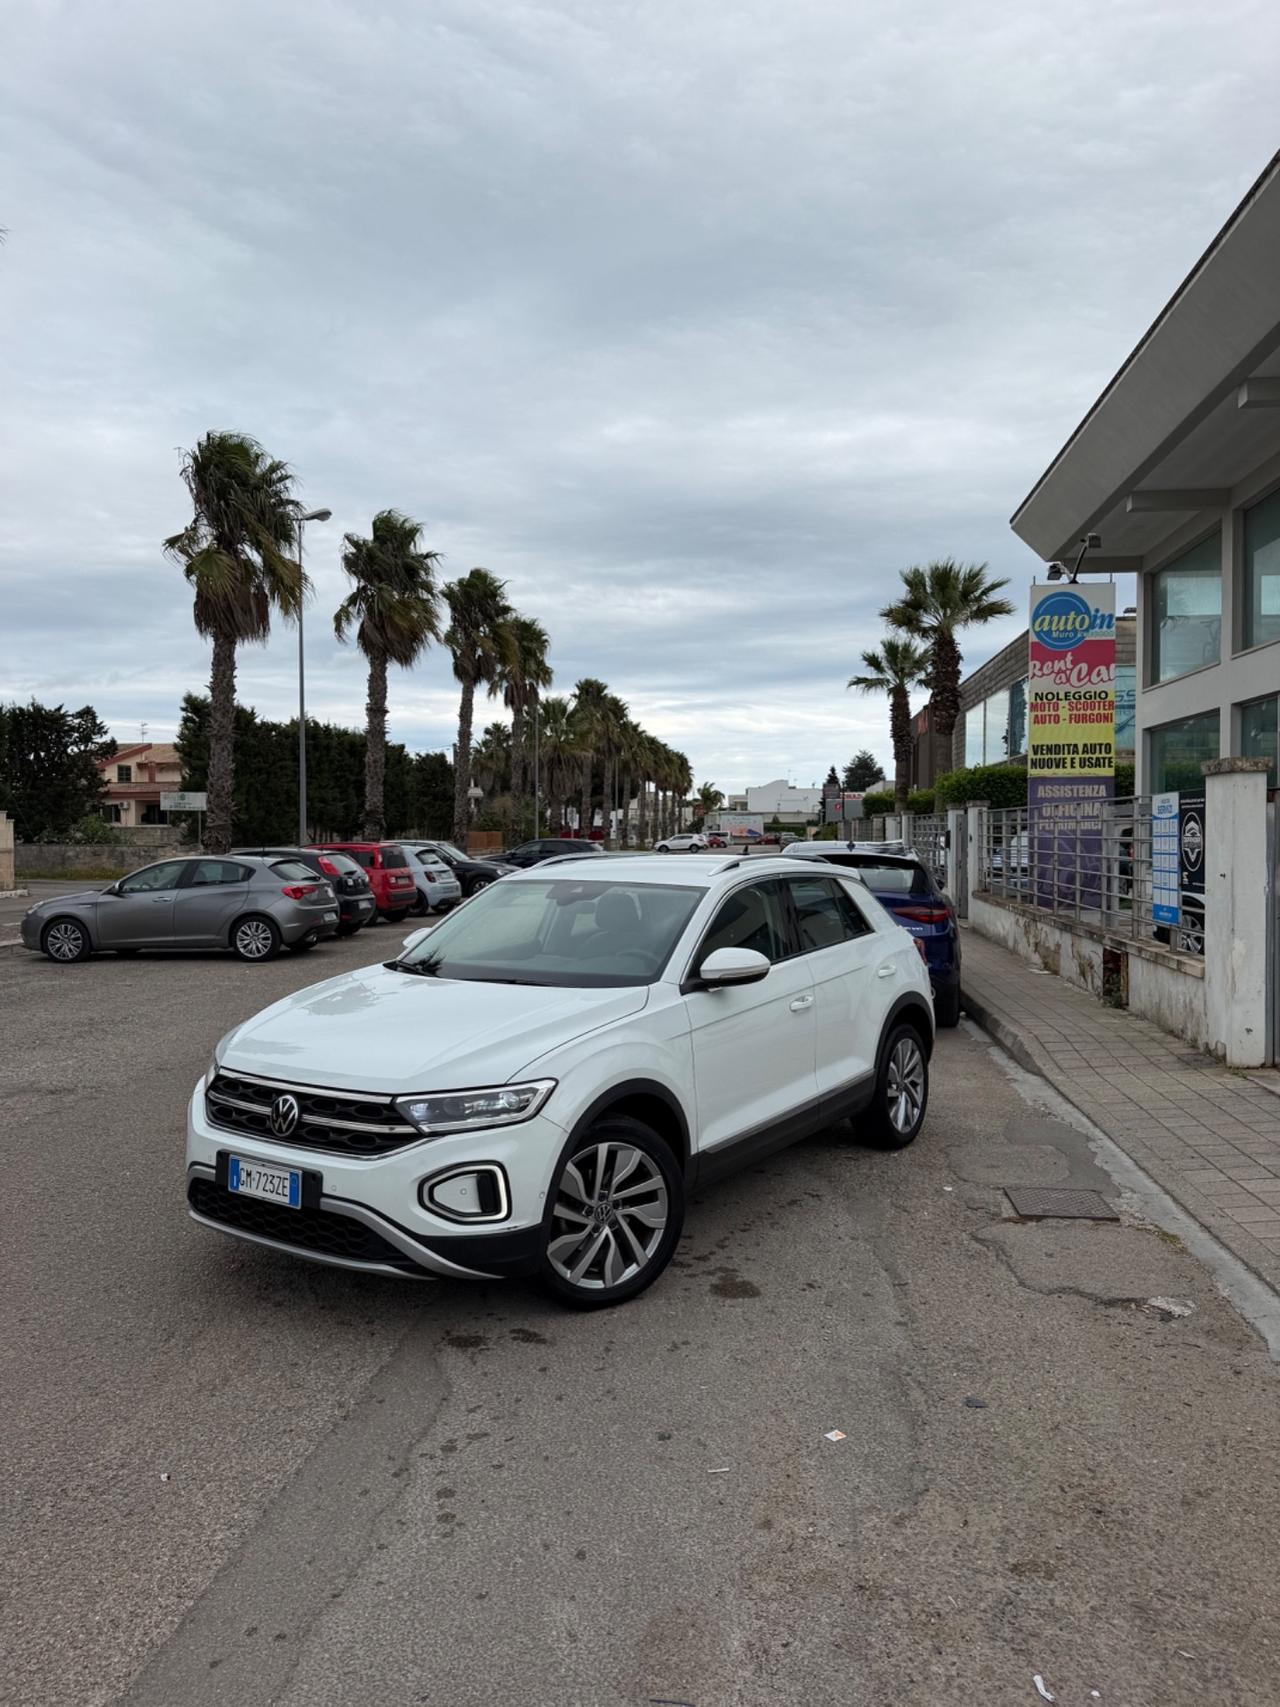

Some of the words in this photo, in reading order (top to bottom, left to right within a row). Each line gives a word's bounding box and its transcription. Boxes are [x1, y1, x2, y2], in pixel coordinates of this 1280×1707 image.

[1029, 652, 1073, 677] Rent
[1034, 690, 1108, 701] NOLEGGIO
[1030, 702, 1059, 712] MOTO
[1068, 700, 1115, 711] SCOOTER
[1033, 714, 1060, 725] AUTO
[1069, 712, 1113, 724] FURGONI
[1032, 743, 1079, 755] VENDITA
[1081, 743, 1112, 755] AUTO
[1030, 757, 1067, 769] NUOVE
[1070, 757, 1076, 769] E
[1079, 756, 1113, 769] USATE
[1037, 785, 1106, 798] ASSISTENZA
